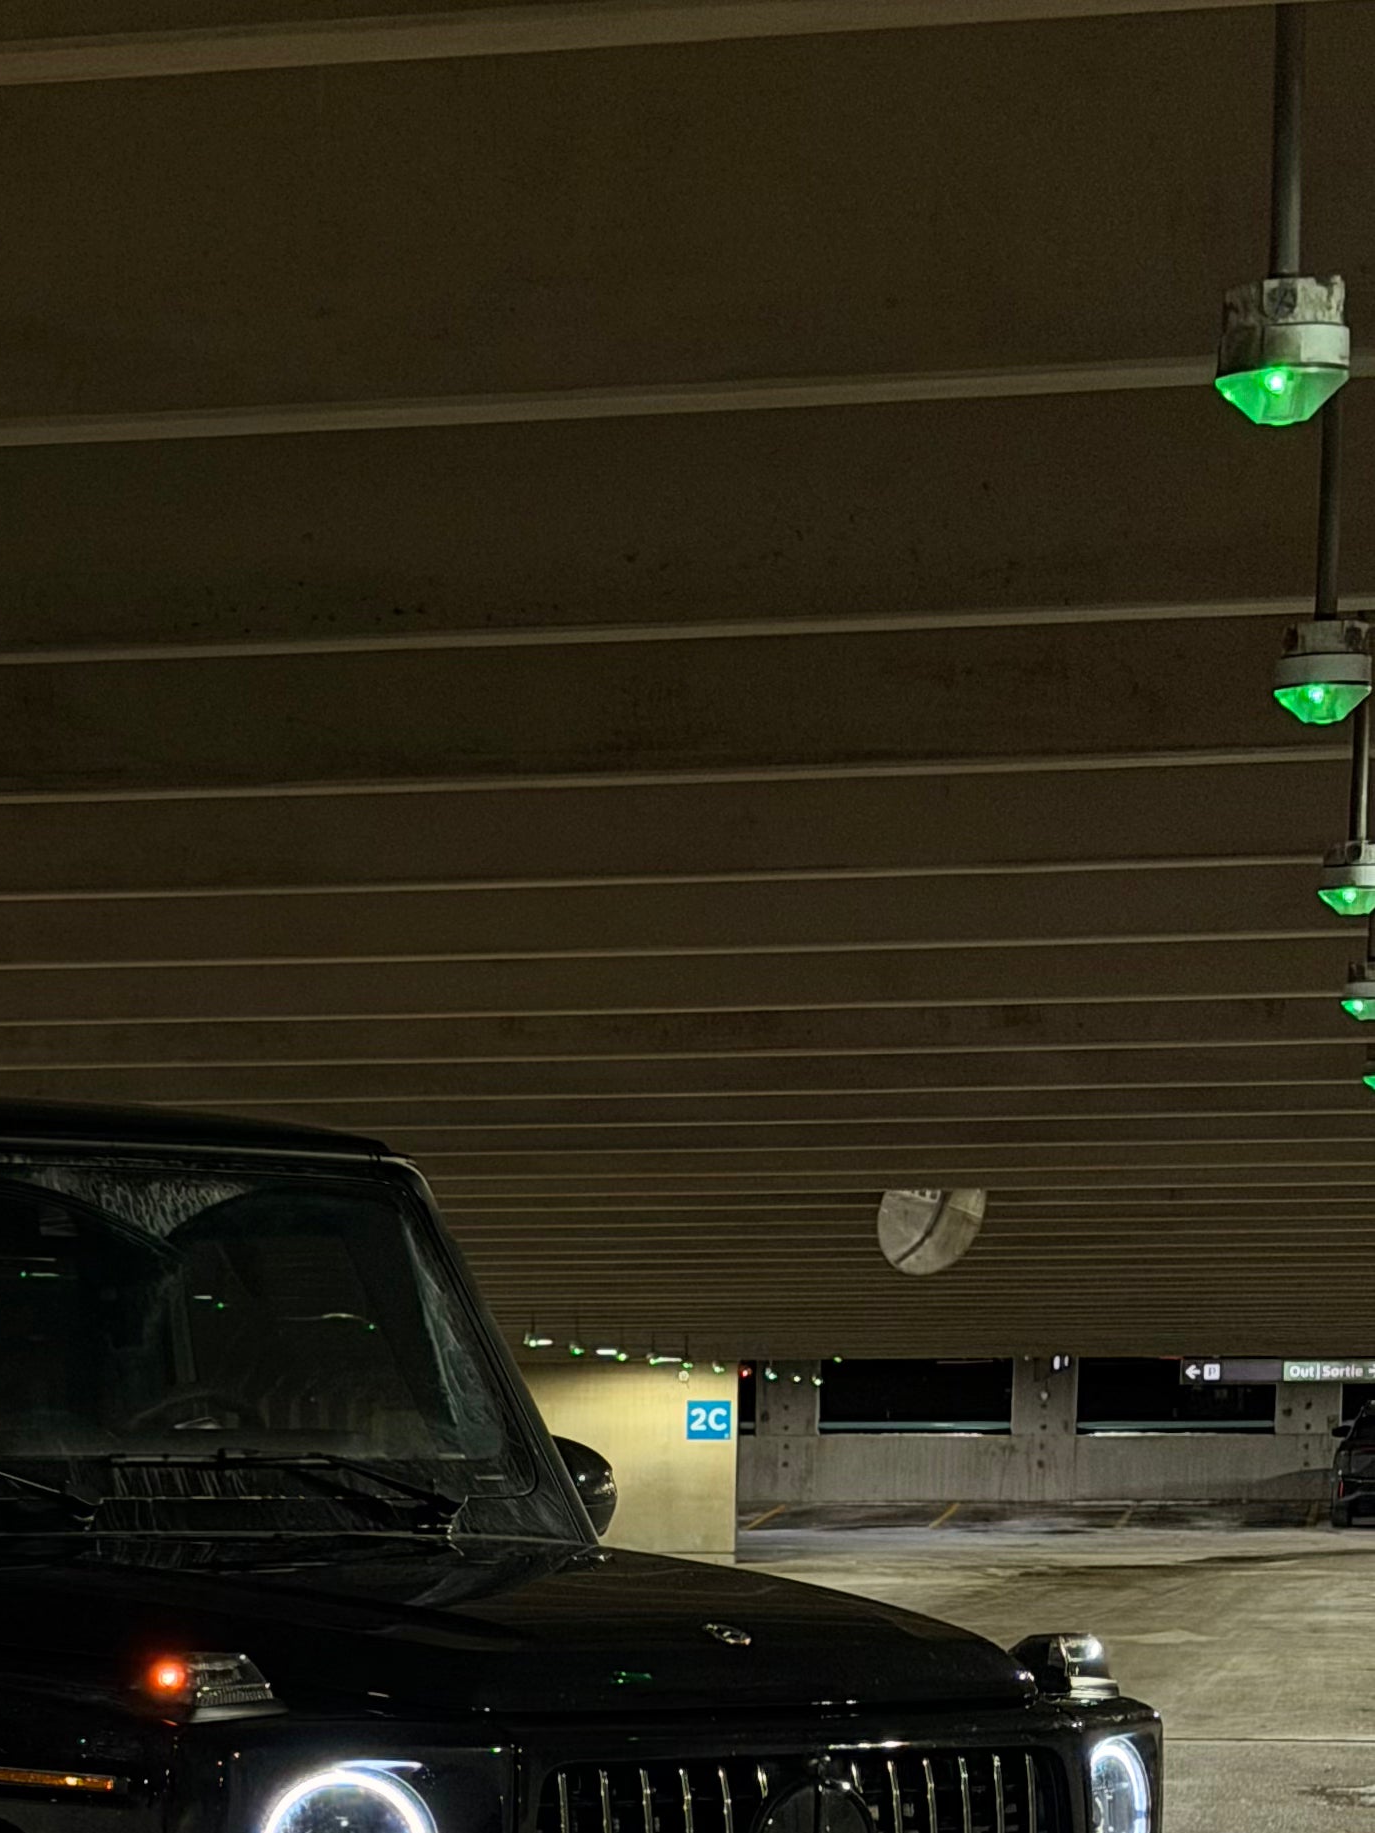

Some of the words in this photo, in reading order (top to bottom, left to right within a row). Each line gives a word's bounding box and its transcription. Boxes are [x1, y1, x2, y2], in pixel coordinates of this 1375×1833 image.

[1289, 1365, 1315, 1378] Out
[1322, 1364, 1364, 1377] Sortie
[690, 1407, 727, 1431] 2C
